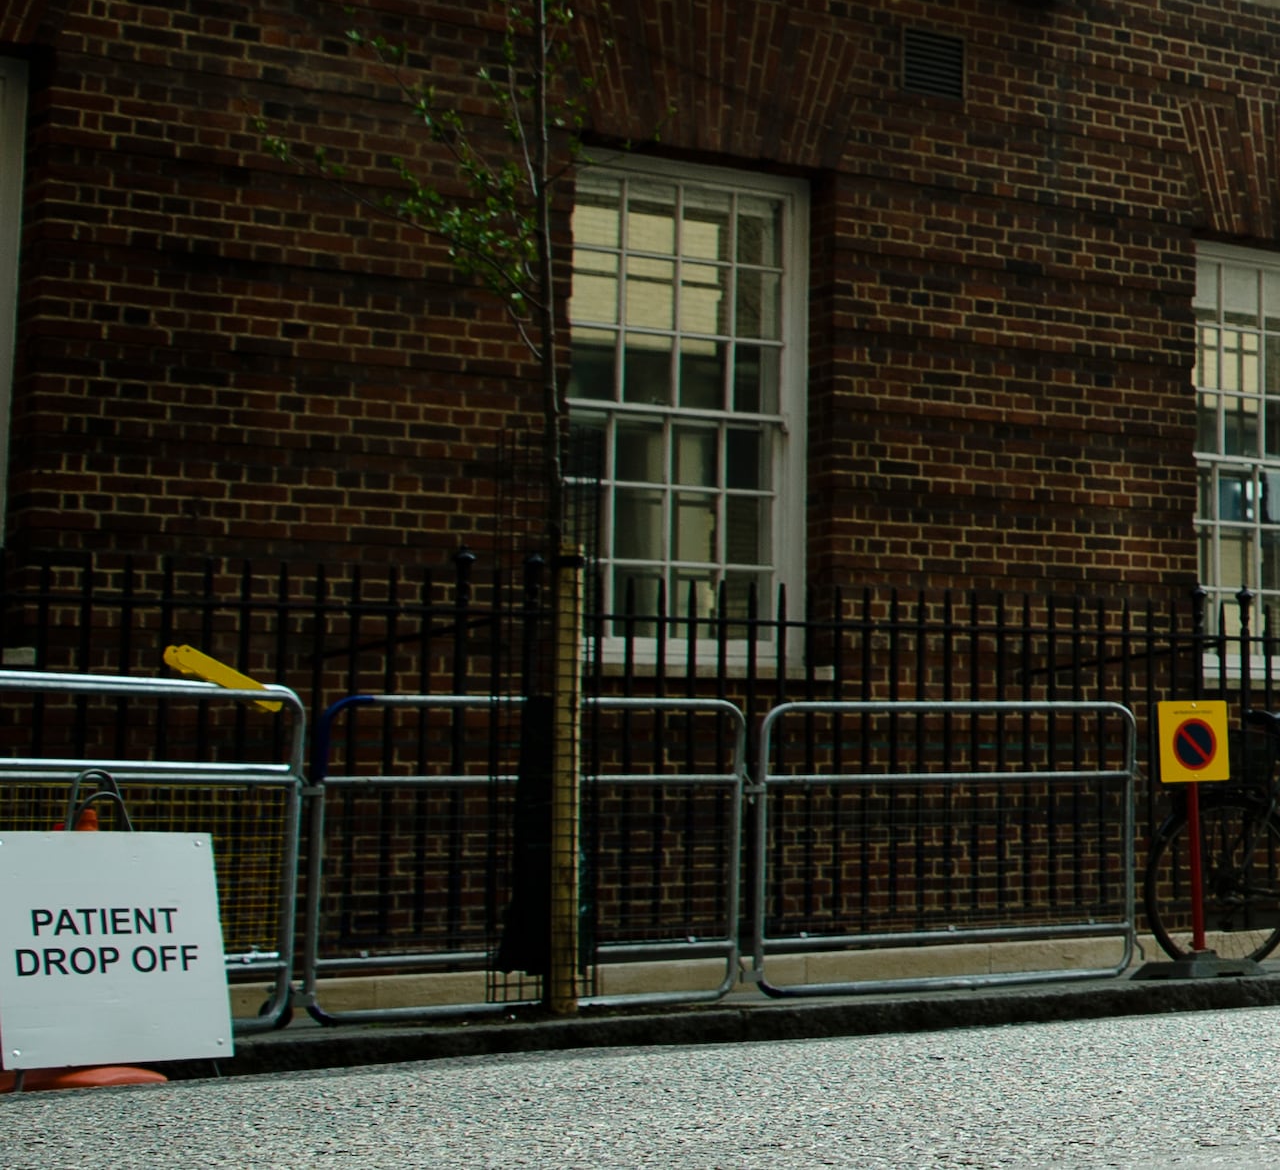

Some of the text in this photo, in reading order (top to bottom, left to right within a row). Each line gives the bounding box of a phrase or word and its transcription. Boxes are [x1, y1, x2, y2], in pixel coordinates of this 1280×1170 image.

[30, 907, 178, 936] PATIENT
[15, 944, 198, 977] DROP OFF
